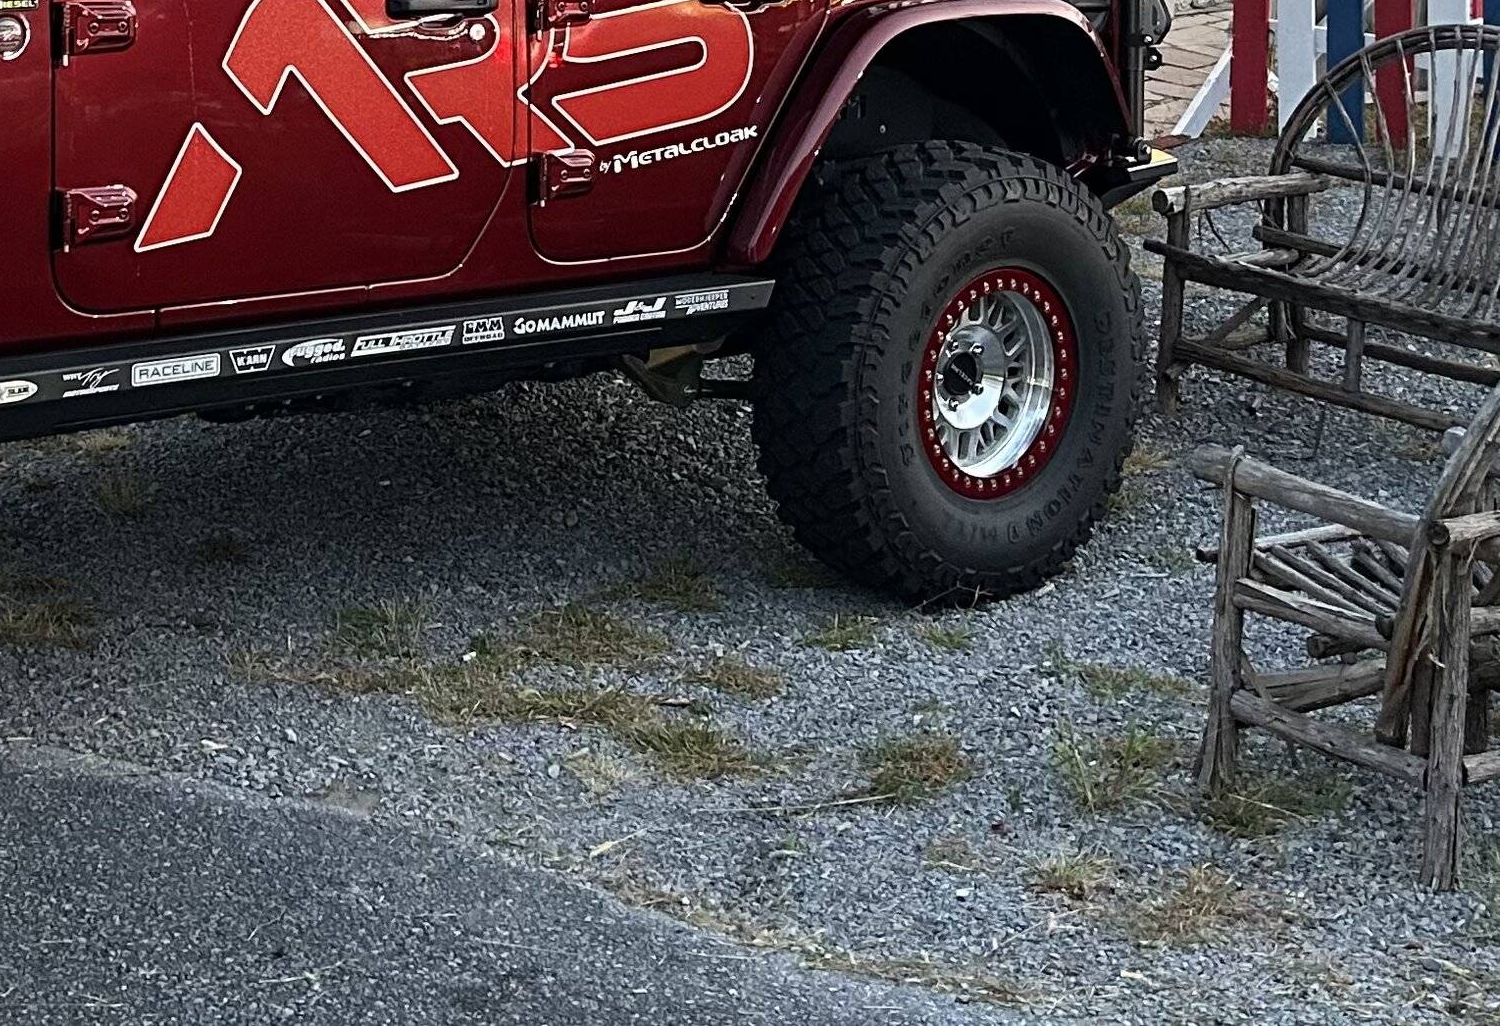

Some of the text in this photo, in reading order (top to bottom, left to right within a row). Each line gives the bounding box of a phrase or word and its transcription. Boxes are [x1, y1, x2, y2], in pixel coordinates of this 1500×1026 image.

[598, 159, 613, 175] by
[356, 338, 386, 351] FULL
[388, 329, 455, 347] THROTTLE
[138, 359, 215, 380] RACELINE
